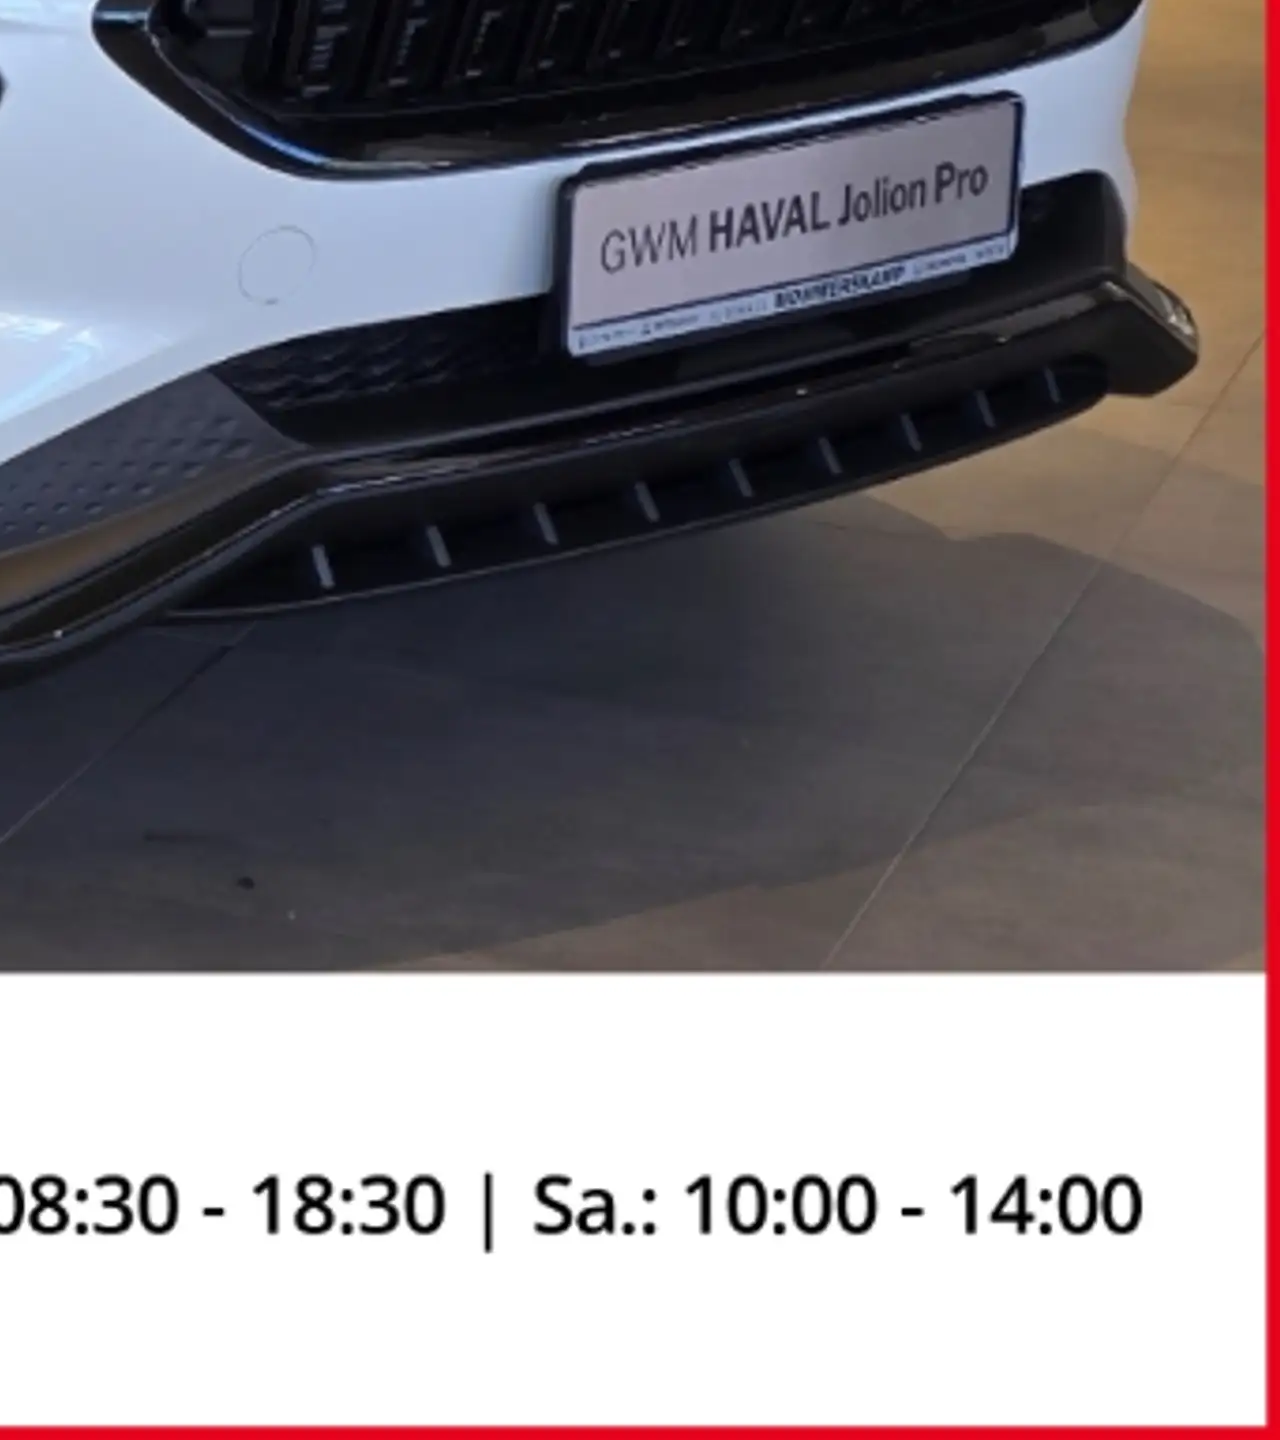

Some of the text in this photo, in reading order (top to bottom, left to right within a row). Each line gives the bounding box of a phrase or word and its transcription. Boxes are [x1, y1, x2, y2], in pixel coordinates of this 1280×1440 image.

[600, 161, 990, 275] GWM HAVAL Jolion Pro
